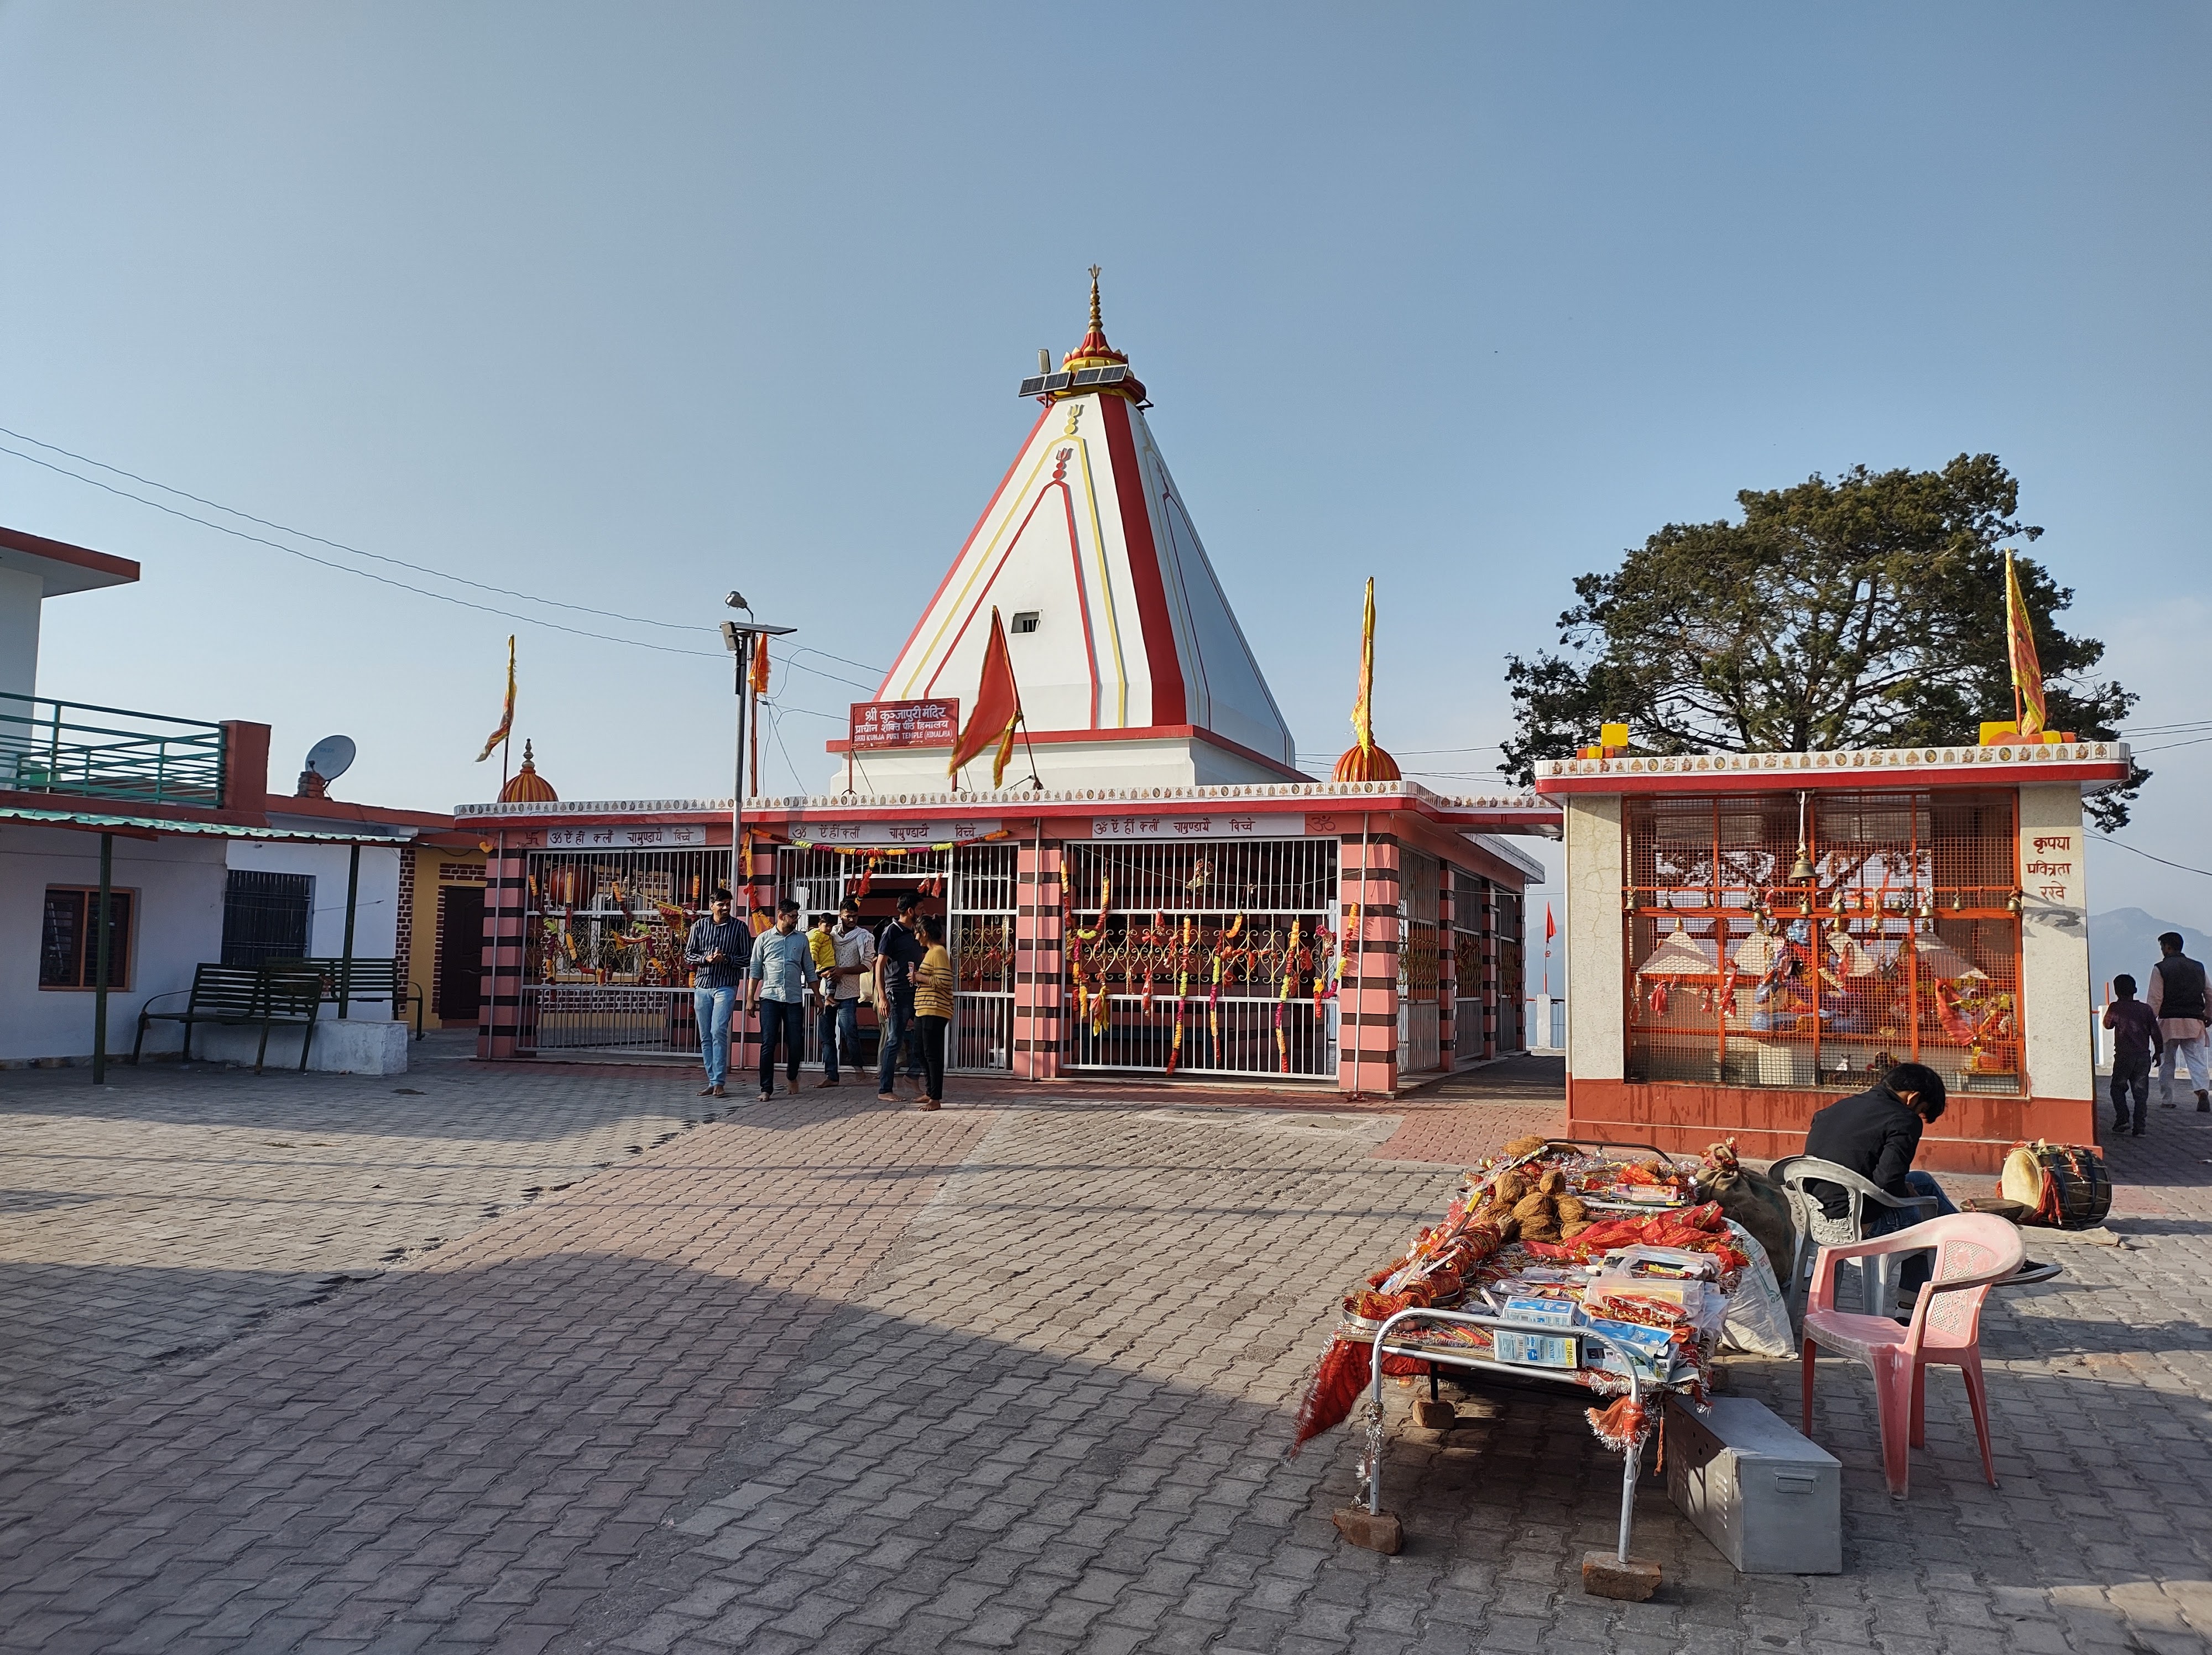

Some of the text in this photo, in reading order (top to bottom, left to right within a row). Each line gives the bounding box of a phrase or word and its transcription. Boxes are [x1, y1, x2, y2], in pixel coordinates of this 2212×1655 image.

[865, 704, 946, 724] श्री कुञ्जापुरी मंदिर
[855, 719, 950, 734] प्राचीन शक्ति पीठ हिमालय
[901, 731, 924, 739] TEMPLE
[924, 729, 953, 740] (HIMALAYA)
[955, 823, 977, 838] विच्चे
[1173, 817, 1212, 834] चामुण्डायै
[1229, 817, 1256, 833] विच्चे
[673, 828, 695, 842] विच्चे
[2033, 837, 2071, 854] कृपया
[2026, 860, 2072, 877] पवित्रता
